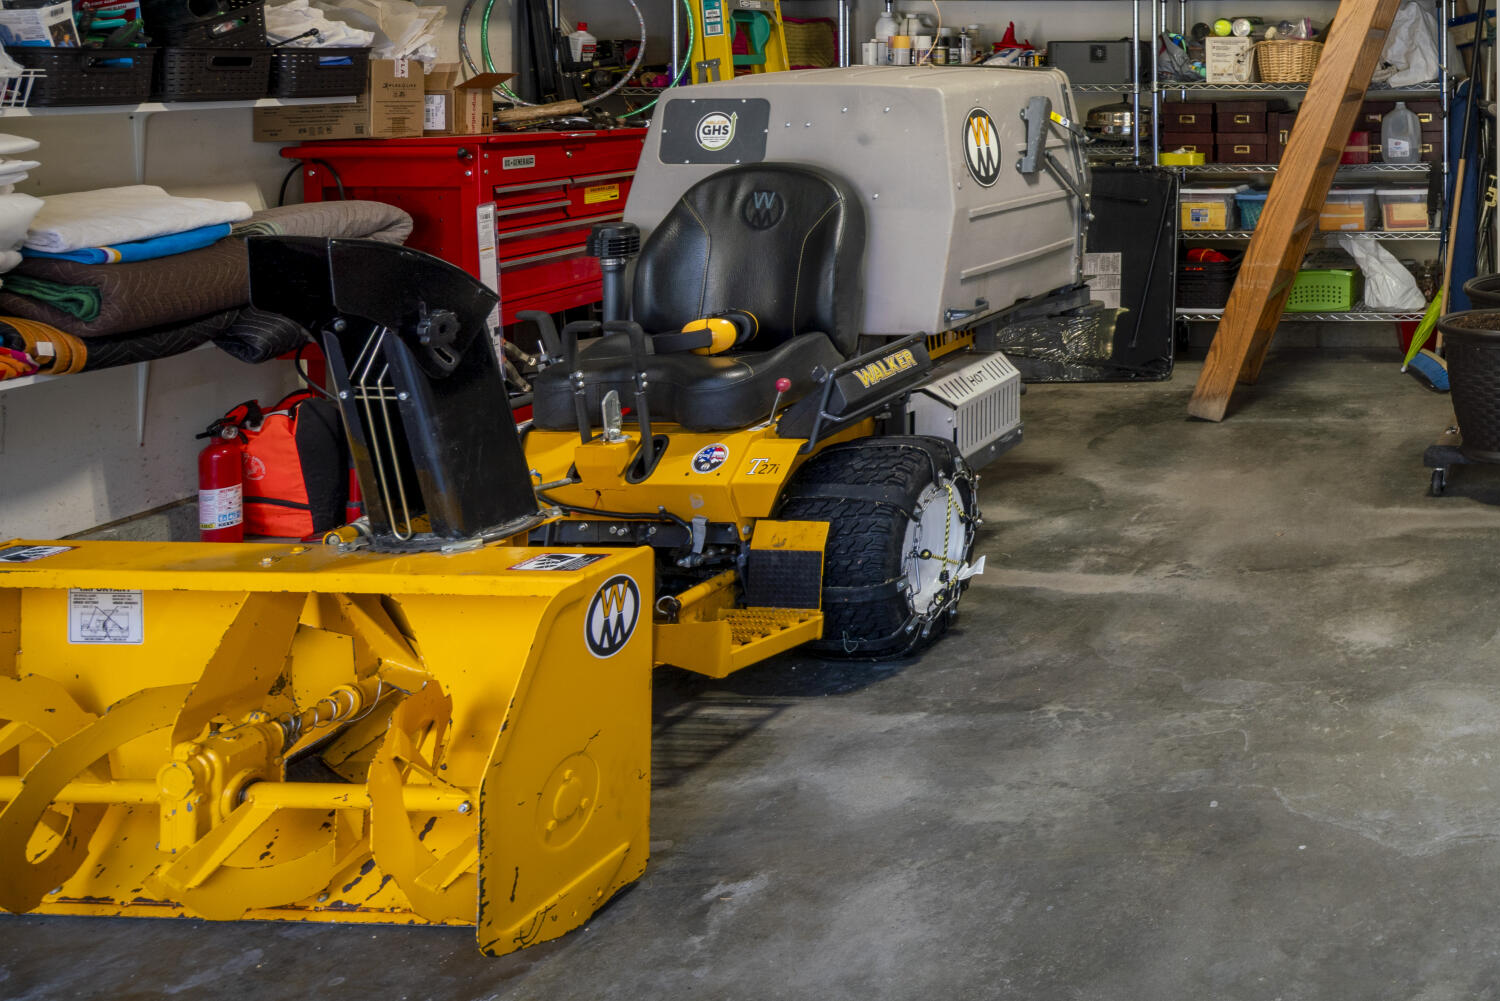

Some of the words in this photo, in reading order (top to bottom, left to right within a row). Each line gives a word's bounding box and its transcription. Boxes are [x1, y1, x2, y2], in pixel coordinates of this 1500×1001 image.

[702, 124, 729, 136] GHS
[853, 348, 918, 389] WALKER
[969, 370, 987, 387] HOT
[745, 457, 780, 476] T27i
